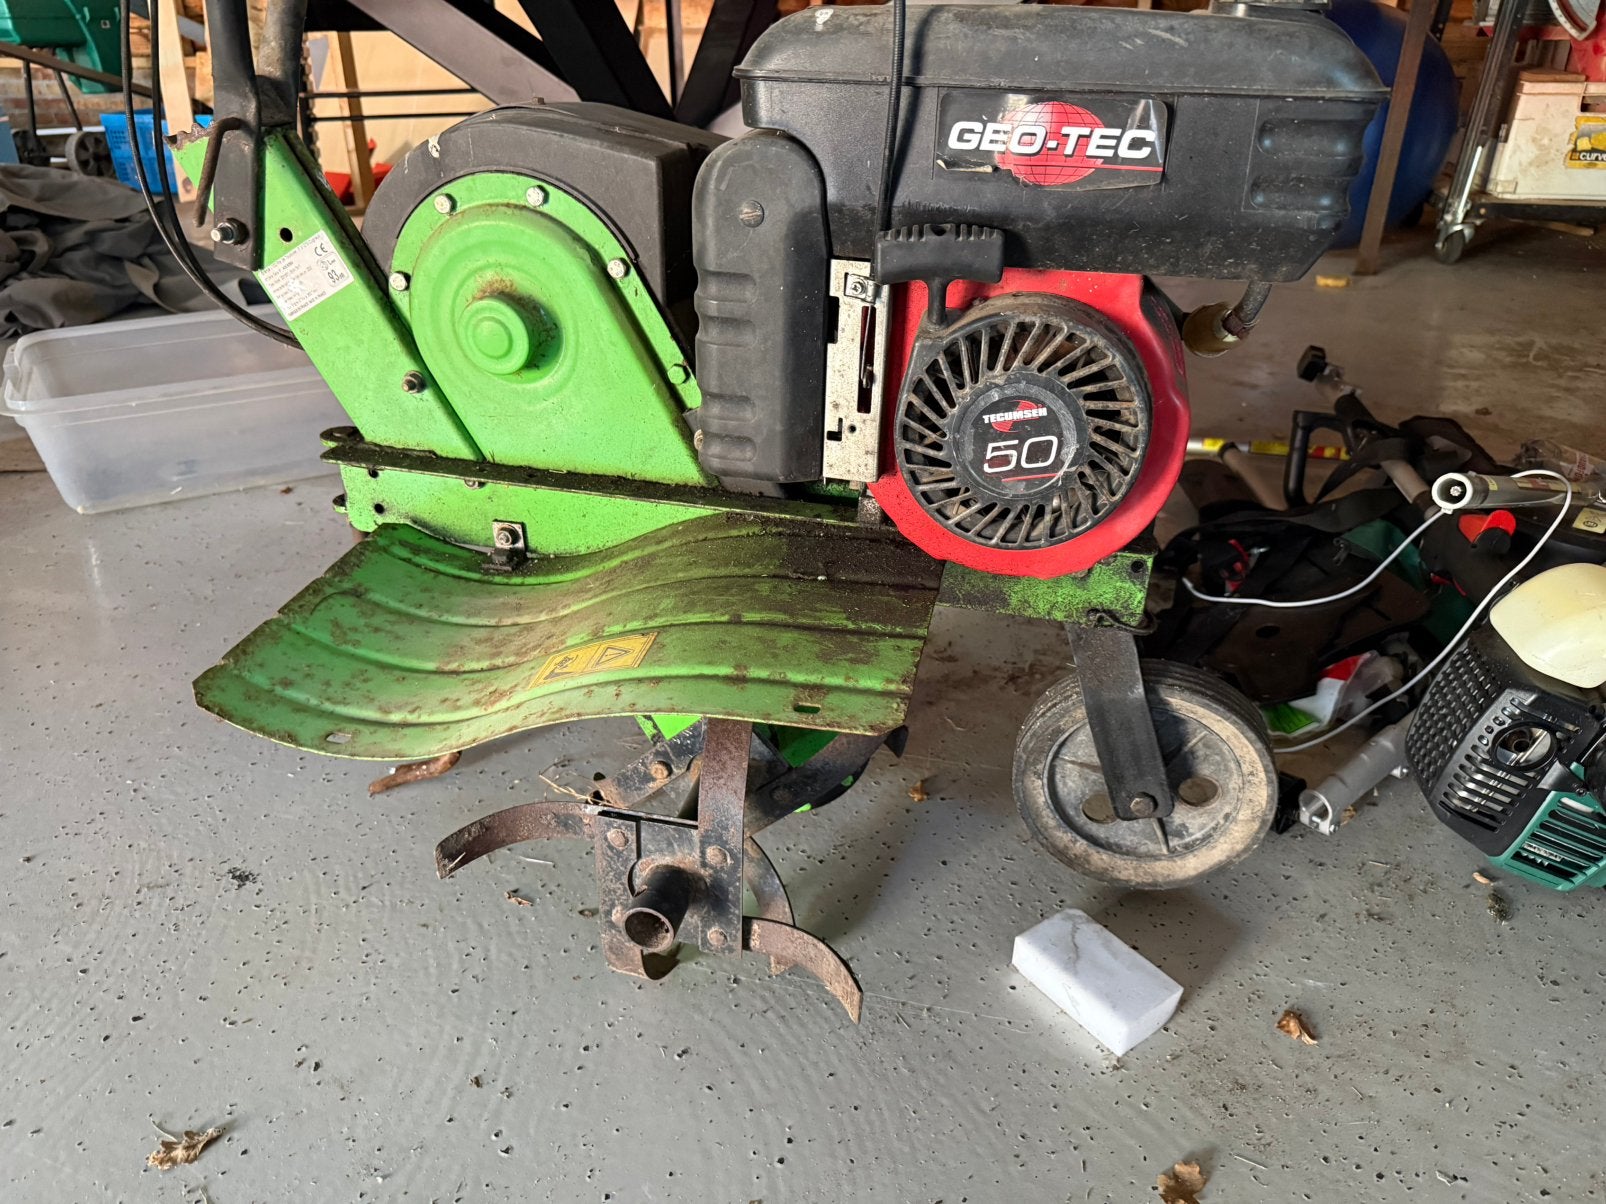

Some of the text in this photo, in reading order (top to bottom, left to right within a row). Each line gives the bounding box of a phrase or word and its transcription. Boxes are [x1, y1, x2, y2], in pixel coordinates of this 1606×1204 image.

[947, 121, 1156, 158] GEO-TEC
[983, 407, 1048, 424] TECUMSEH
[983, 435, 1058, 473] 50
